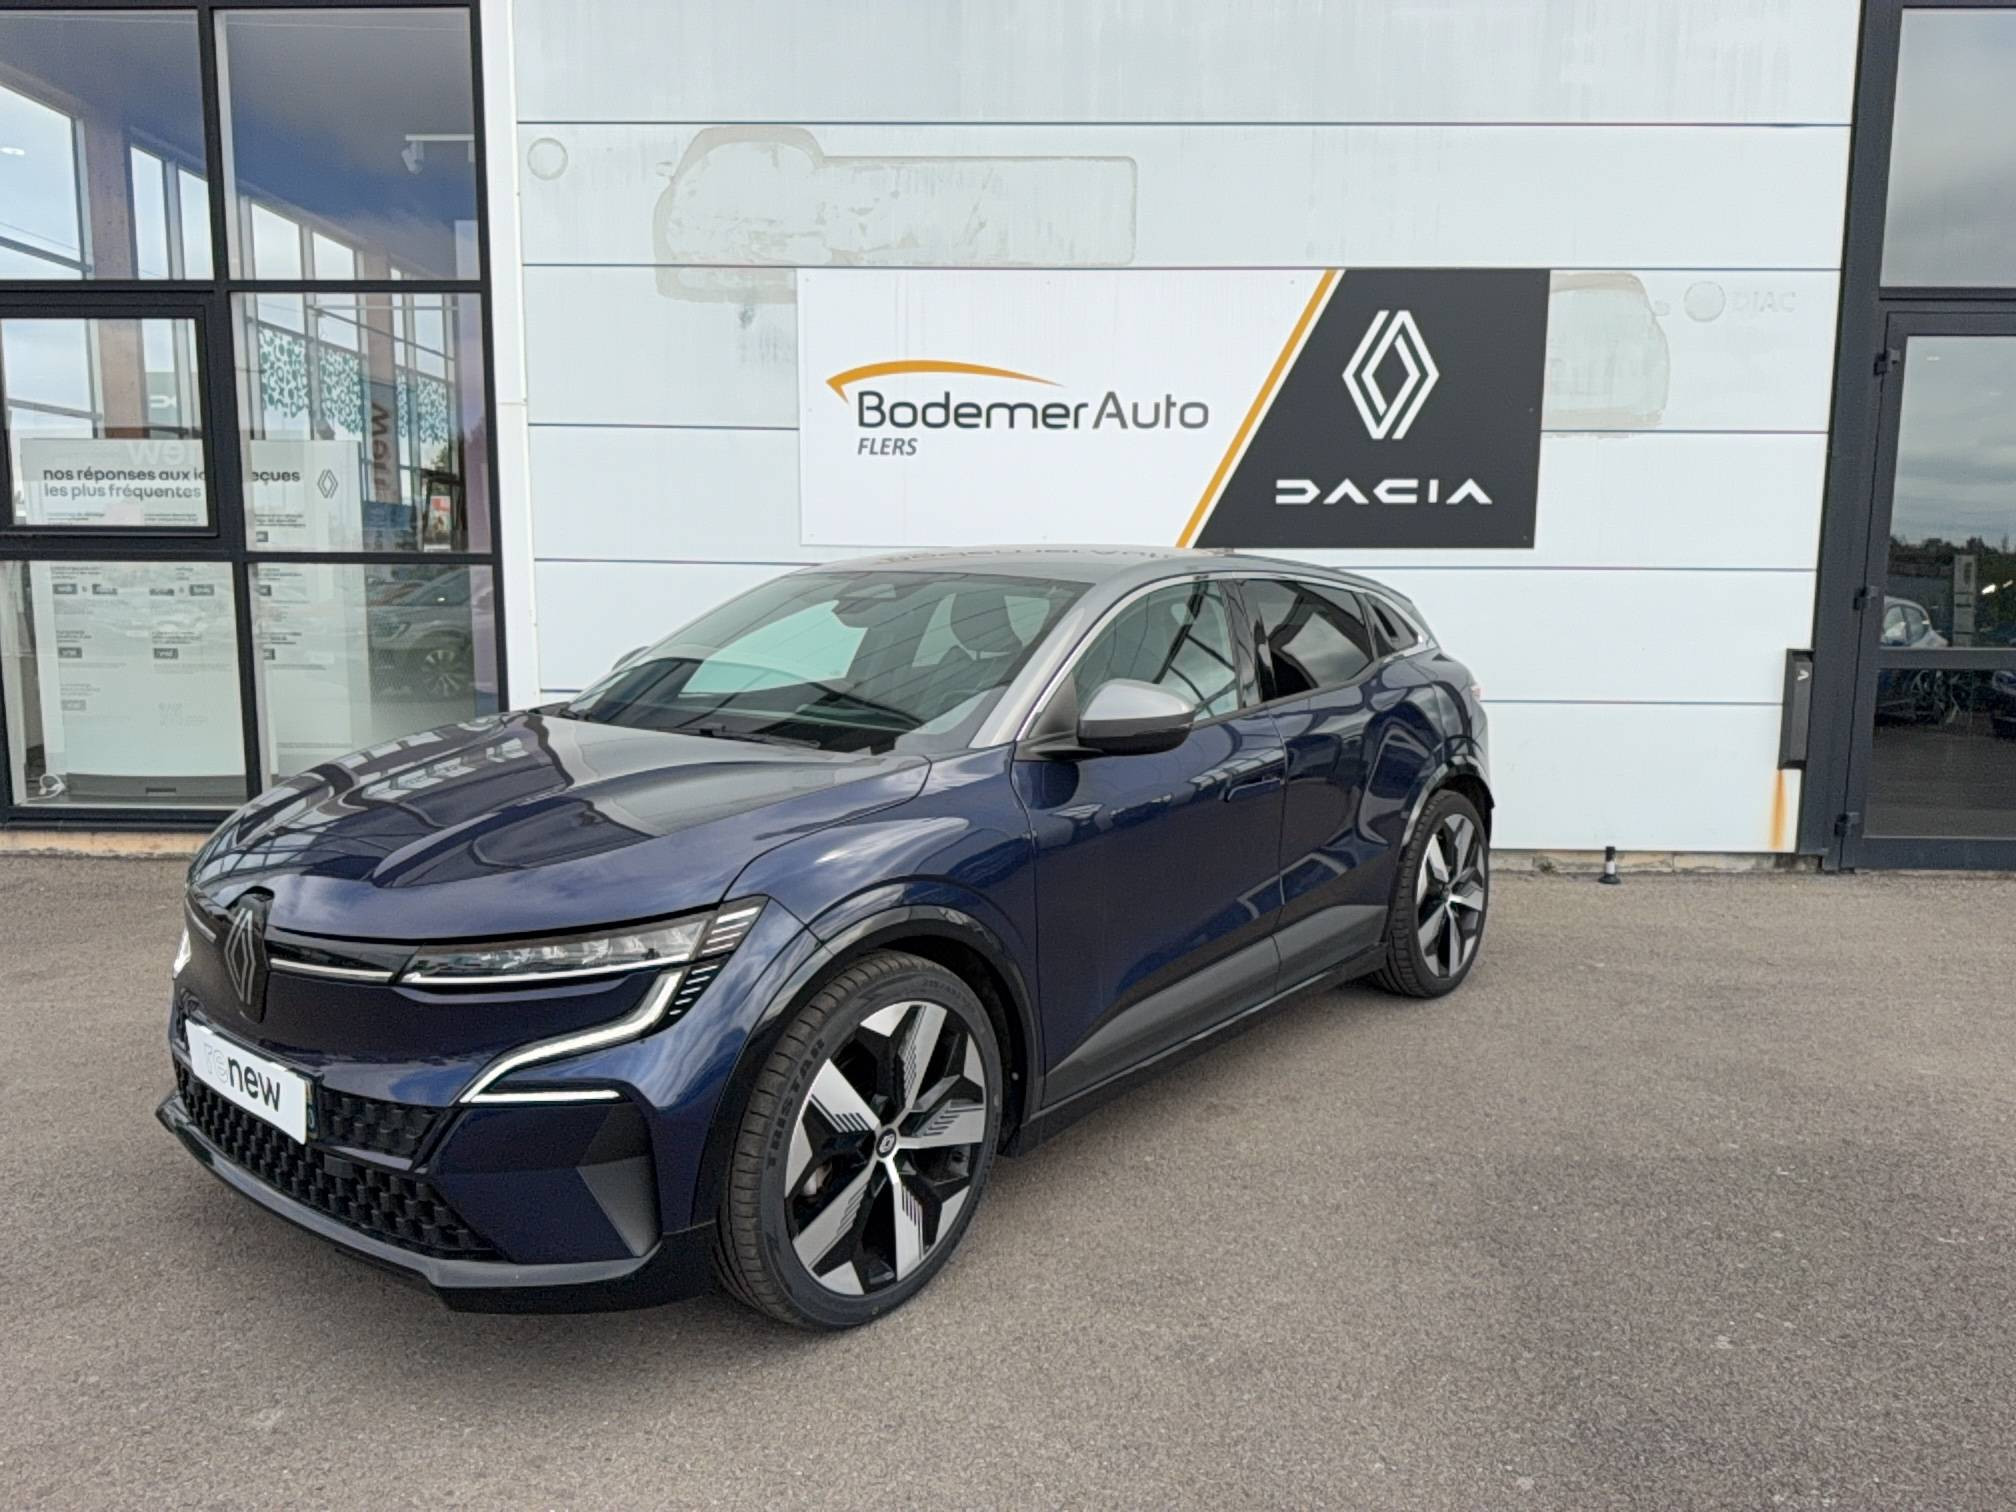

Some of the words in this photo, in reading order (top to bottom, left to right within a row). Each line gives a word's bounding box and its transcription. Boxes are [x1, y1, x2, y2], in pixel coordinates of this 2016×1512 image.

[857, 437, 918, 456] FLERS
[43, 469, 74, 481] nos
[78, 466, 156, 483] réponses
[158, 469, 190, 481] aux
[251, 471, 301, 486] eçues
[44, 483, 68, 497] les
[72, 484, 106, 500] plus
[109, 484, 202, 501] fréquentes
[1275, 478, 1493, 504] DACIA
